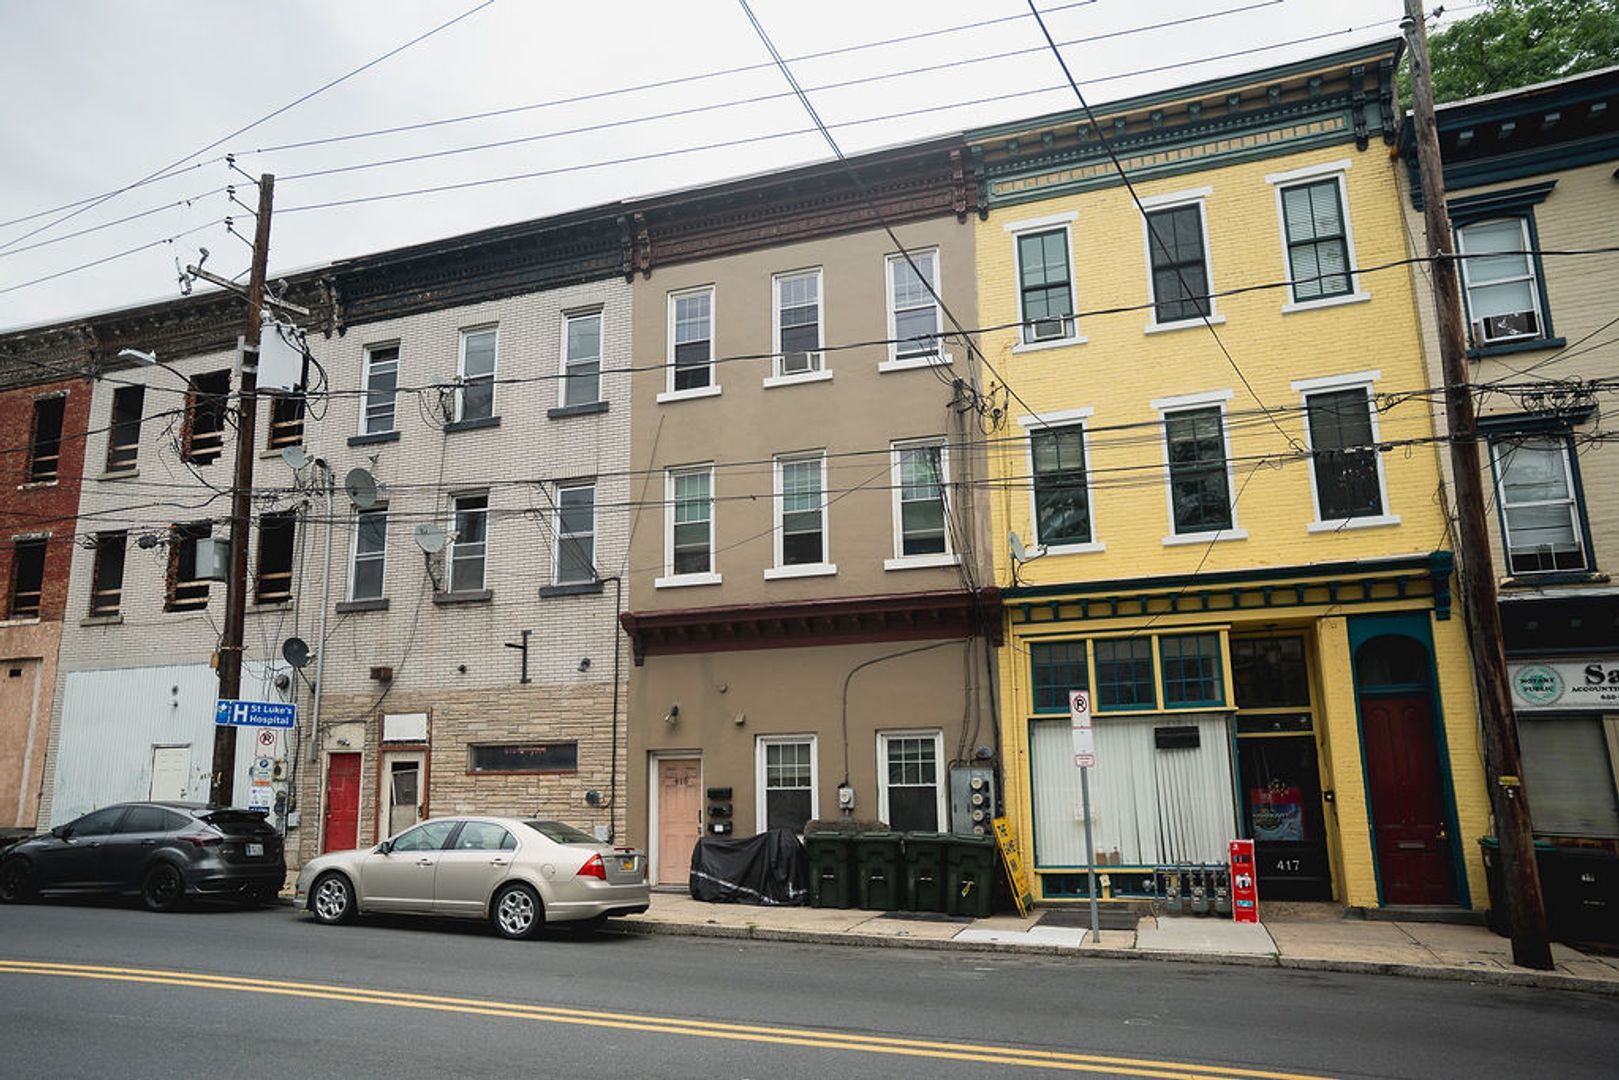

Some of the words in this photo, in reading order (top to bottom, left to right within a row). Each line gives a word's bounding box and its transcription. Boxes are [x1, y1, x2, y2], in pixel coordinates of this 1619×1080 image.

[1519, 676, 1556, 684] NOTARY
[233, 703, 249, 722] H
[251, 704, 262, 712] St
[263, 705, 292, 714] Luke's
[250, 715, 289, 725] Hospital
[1276, 860, 1300, 871] 417
